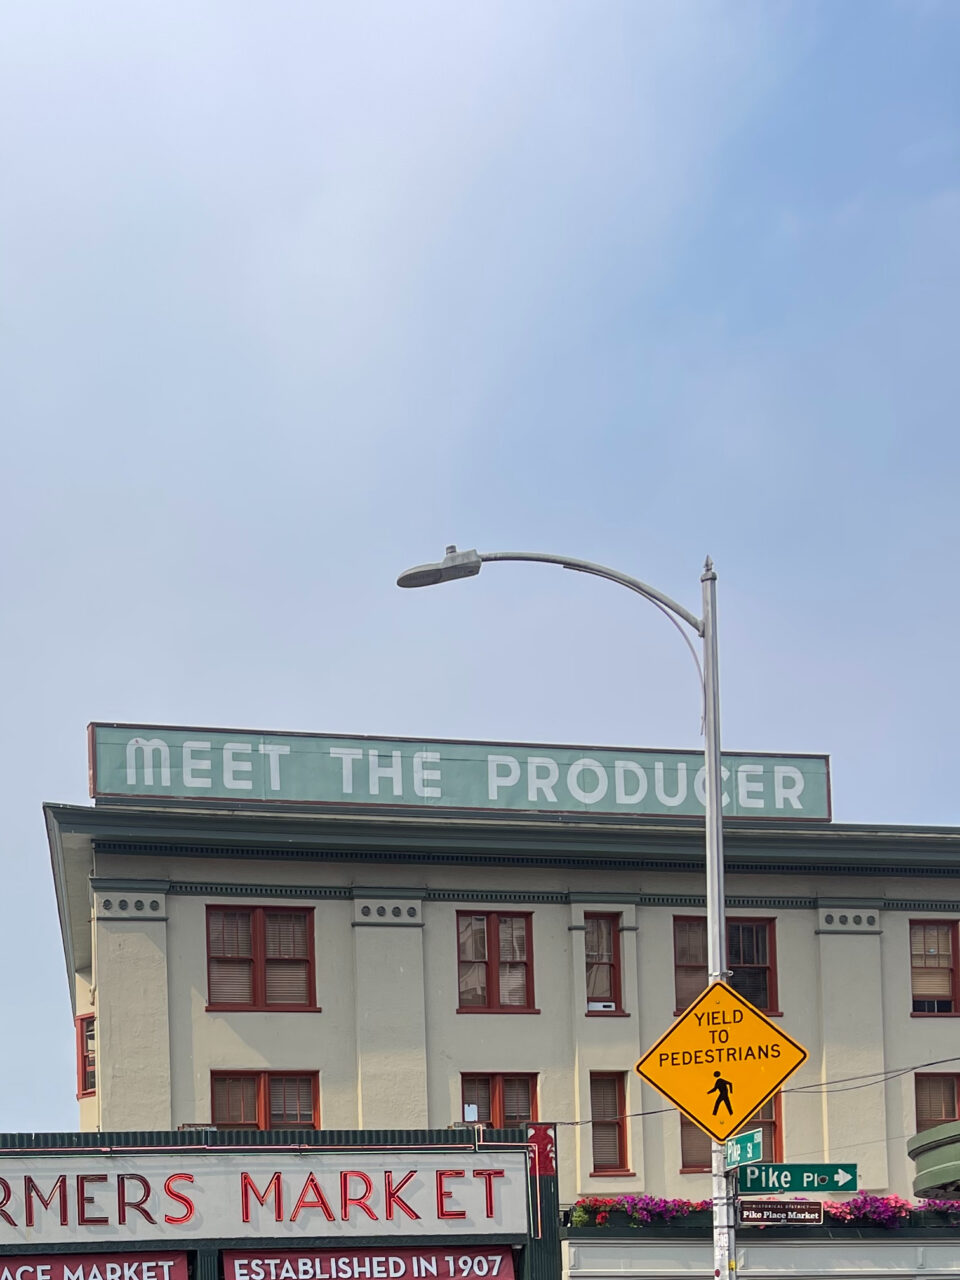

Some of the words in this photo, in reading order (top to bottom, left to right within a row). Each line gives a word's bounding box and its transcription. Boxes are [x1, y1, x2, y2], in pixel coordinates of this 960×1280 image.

[126, 737, 290, 791] MEET
[330, 747, 441, 797] THE
[487, 754, 805, 810] PRODUCER
[694, 1010, 743, 1026] YIELD
[709, 1029, 729, 1044] TO
[659, 1044, 781, 1067] PEDESTRIANS
[728, 1141, 741, 1163] Pike
[746, 1167, 791, 1188] Pike
[241, 1168, 506, 1222] MARKET
[234, 1256, 406, 1280] ESTABLISHED
[412, 1256, 437, 1278] IN
[444, 1255, 502, 1277] 1907
